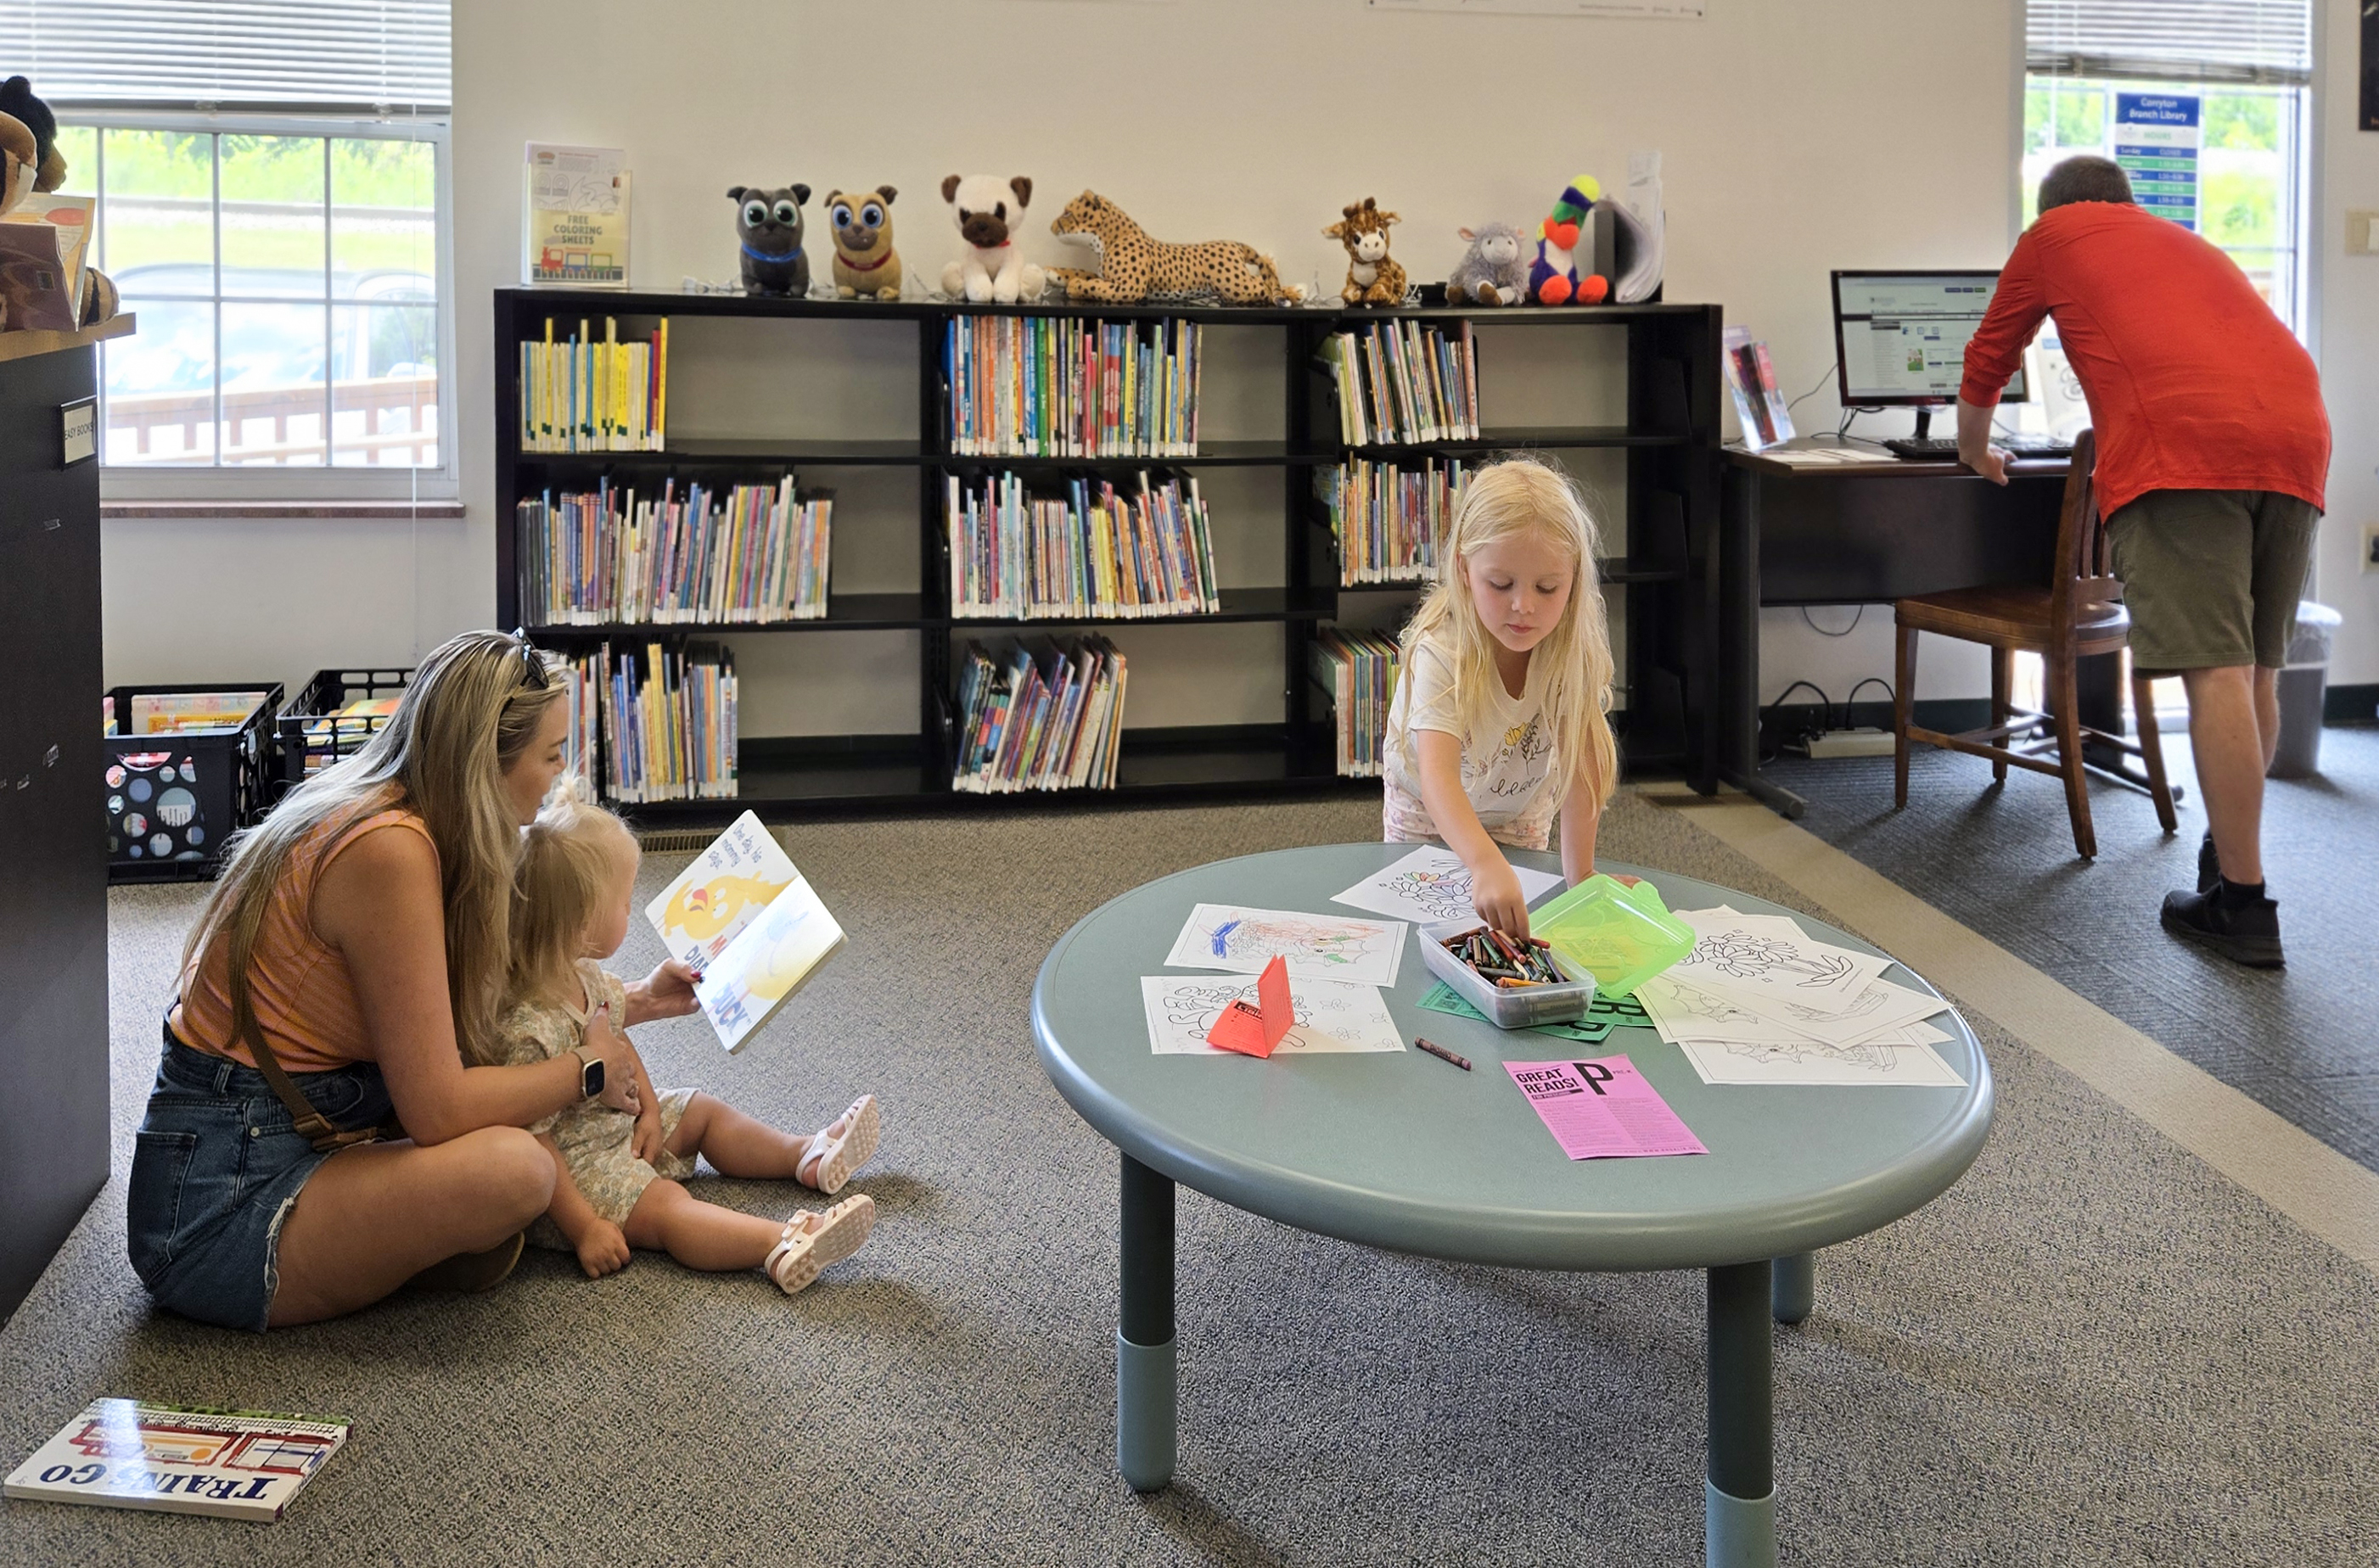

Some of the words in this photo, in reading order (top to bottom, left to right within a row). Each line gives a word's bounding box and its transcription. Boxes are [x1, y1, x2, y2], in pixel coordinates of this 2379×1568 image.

[2129, 109, 2158, 119] Branch
[2160, 111, 2187, 122] Library
[567, 216, 589, 225] FREE
[553, 224, 603, 235] COLORING
[561, 235, 594, 245] SHEETS
[1516, 1068, 1563, 1083] GREAT
[1572, 1062, 1614, 1096] P
[1523, 1078, 1579, 1094] READS!
[40, 1463, 107, 1485] GO
